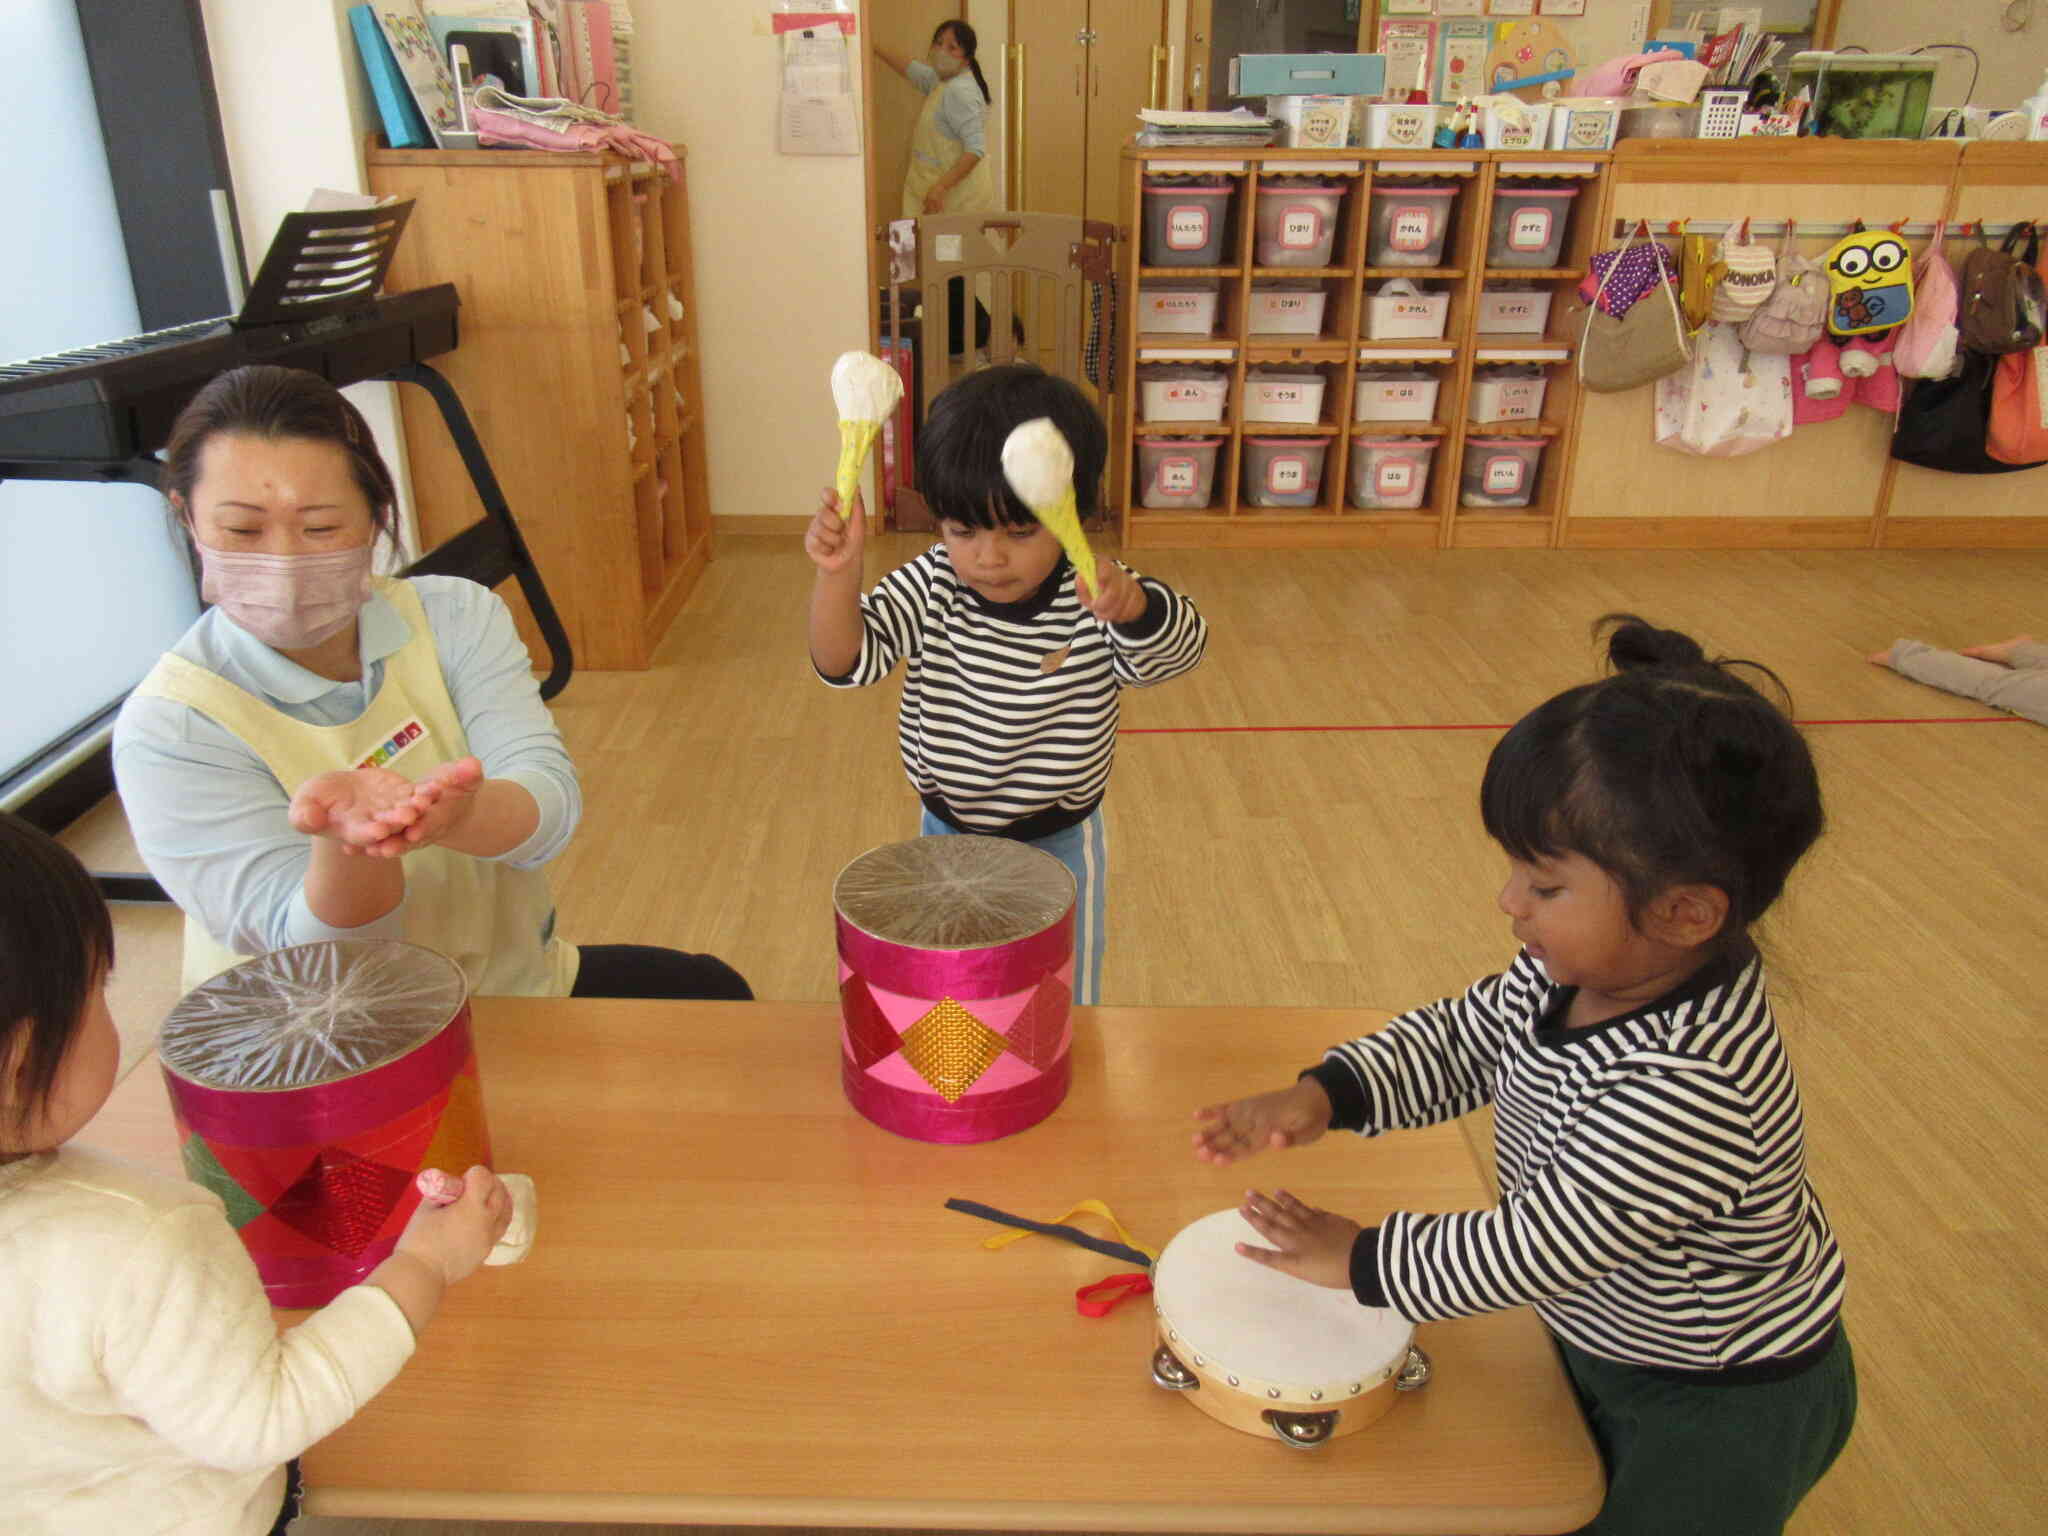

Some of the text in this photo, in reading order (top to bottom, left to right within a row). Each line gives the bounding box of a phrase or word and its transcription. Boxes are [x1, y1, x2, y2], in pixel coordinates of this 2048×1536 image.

[1289, 223, 1310, 233] ひまり
[1400, 223, 1422, 233] かれん
[1280, 300, 1301, 309] ひまり
[1408, 306, 1428, 314] かれん
[1277, 391, 1297, 400] そうま
[1279, 470, 1298, 479] そうま
